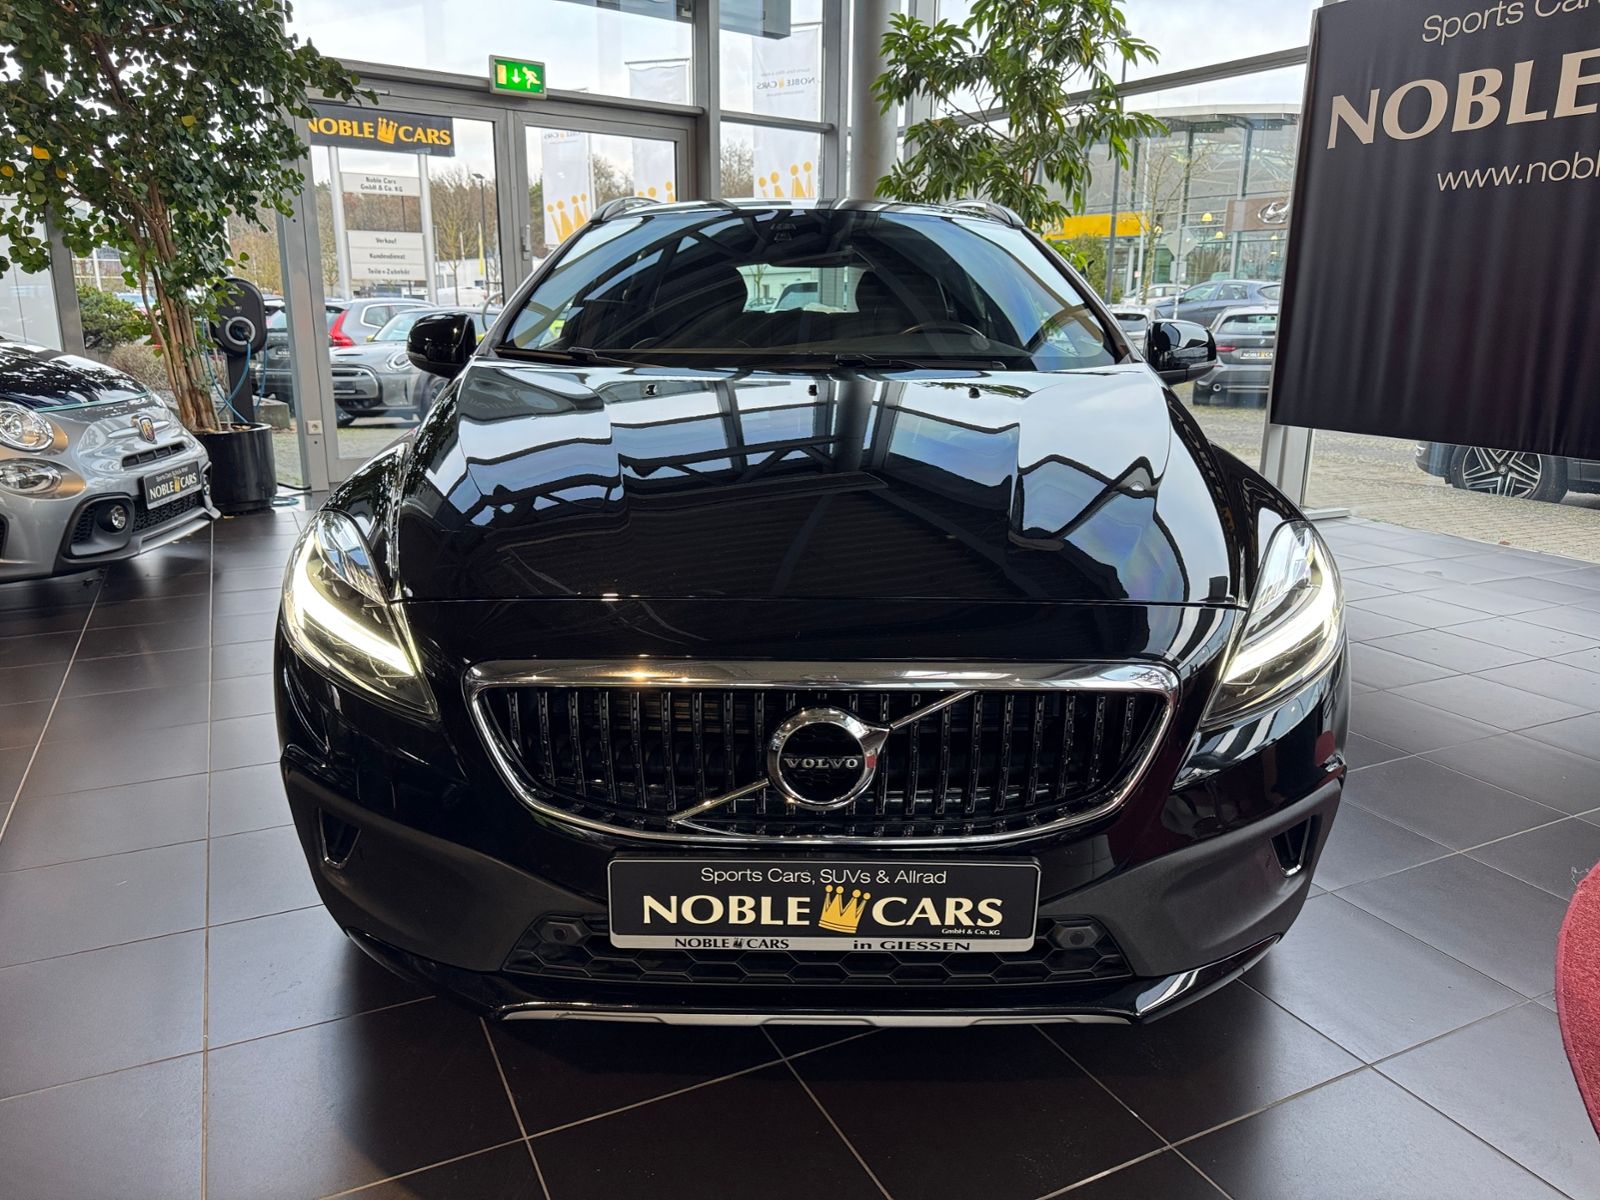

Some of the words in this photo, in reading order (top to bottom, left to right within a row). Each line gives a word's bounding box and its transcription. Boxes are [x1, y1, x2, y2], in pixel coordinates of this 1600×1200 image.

[1422, 0, 1524, 46] Sports
[1327, 47, 1600, 150] NOBLE
[307, 117, 375, 138] NOBLE
[398, 125, 452, 146] CARS
[149, 481, 174, 500] NOBLE
[180, 472, 197, 488] CARS
[784, 758, 859, 769] VOLVO
[701, 867, 763, 884] Sports
[767, 868, 816, 885] Cars,
[820, 868, 871, 884] SUVs
[875, 869, 891, 884] &
[894, 870, 947, 884] Allrad
[643, 894, 811, 926] NOBLE
[871, 896, 1004, 927] CARS
[674, 937, 730, 948] NOBLE
[746, 938, 790, 949] CARS
[853, 940, 872, 950] in
[879, 940, 971, 951] GIESSEN
